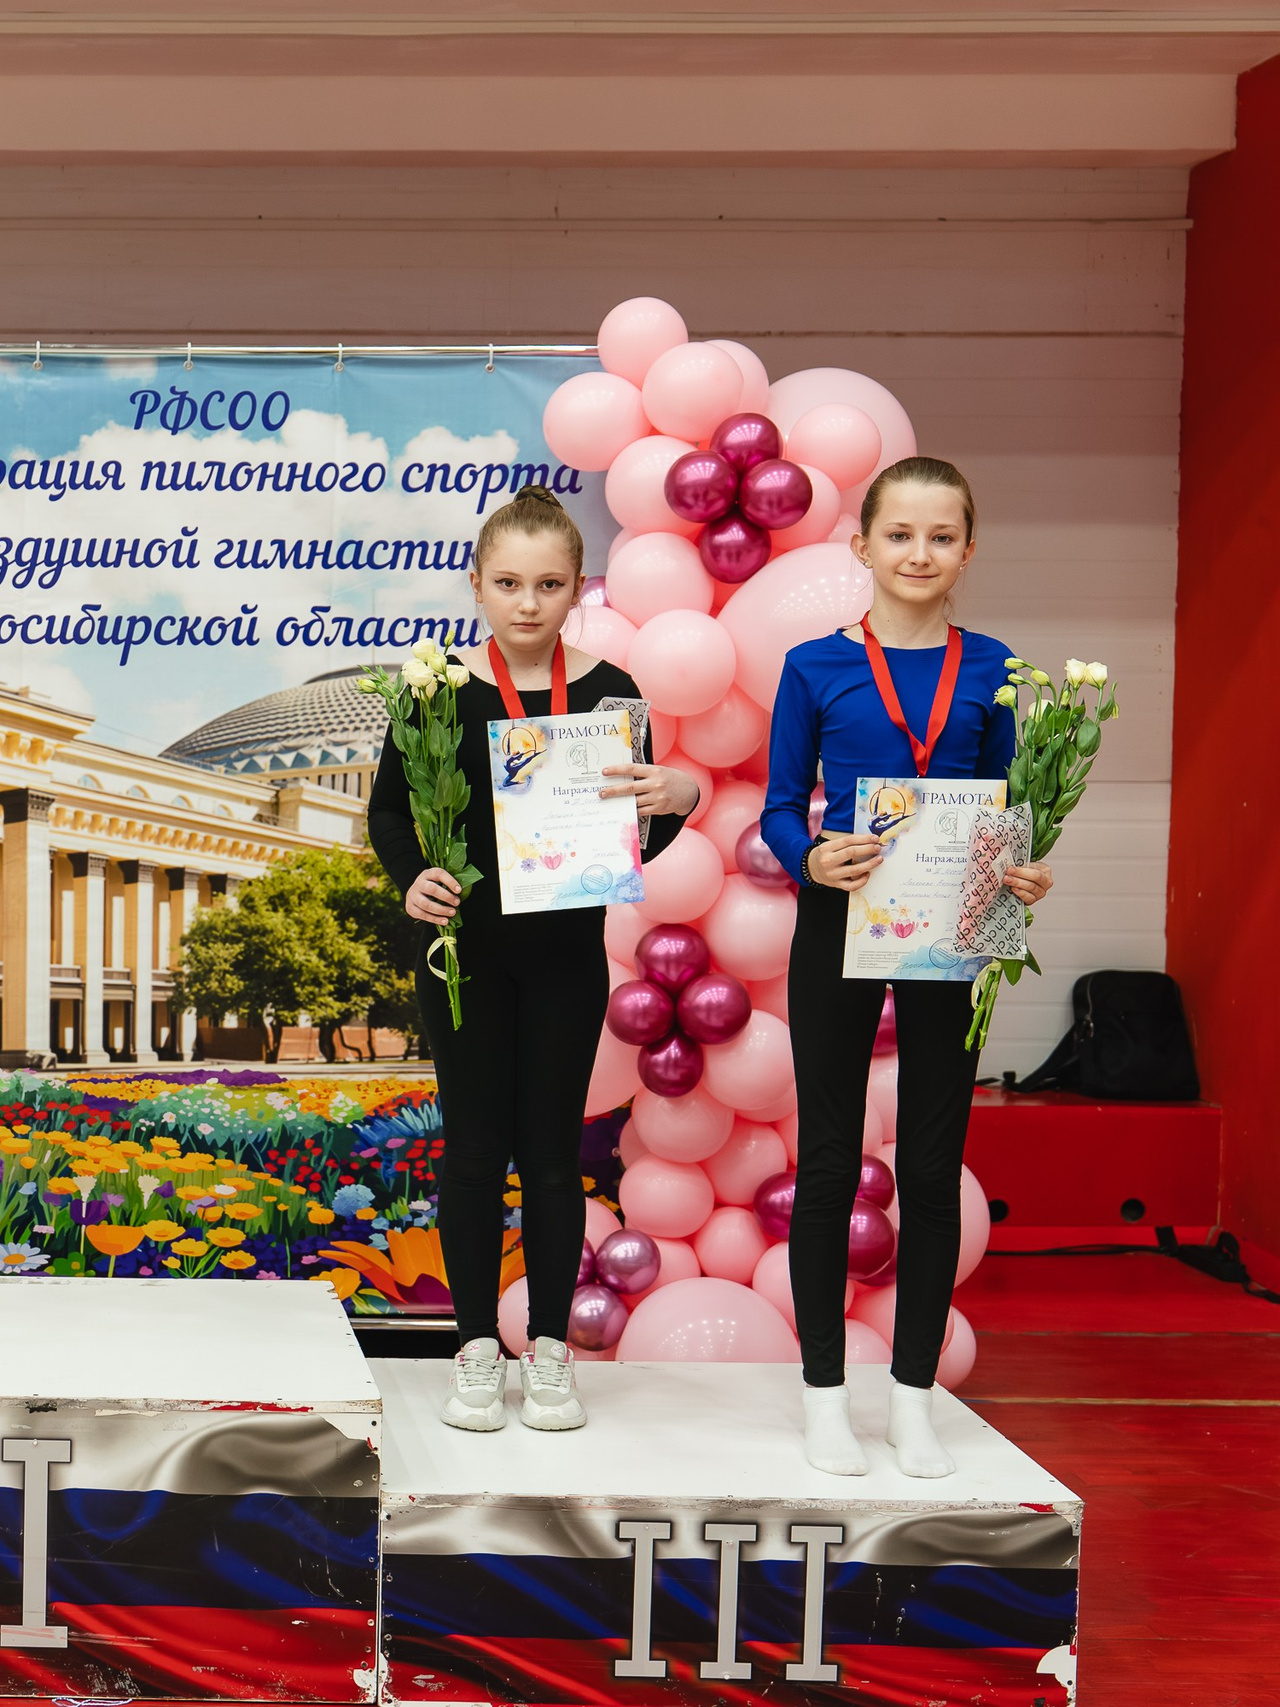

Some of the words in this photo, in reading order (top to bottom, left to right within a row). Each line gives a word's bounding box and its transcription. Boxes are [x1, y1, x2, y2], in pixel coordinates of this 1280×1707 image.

[130, 386, 290, 434] РФСОО
[141, 460, 387, 493] пилонного
[402, 461, 583, 514] спорта
[550, 723, 620, 740] ГРАМОТА
[921, 793, 994, 805] ГРАМОТА
[0, 1438, 71, 1647] I
[615, 1521, 843, 1682] III
